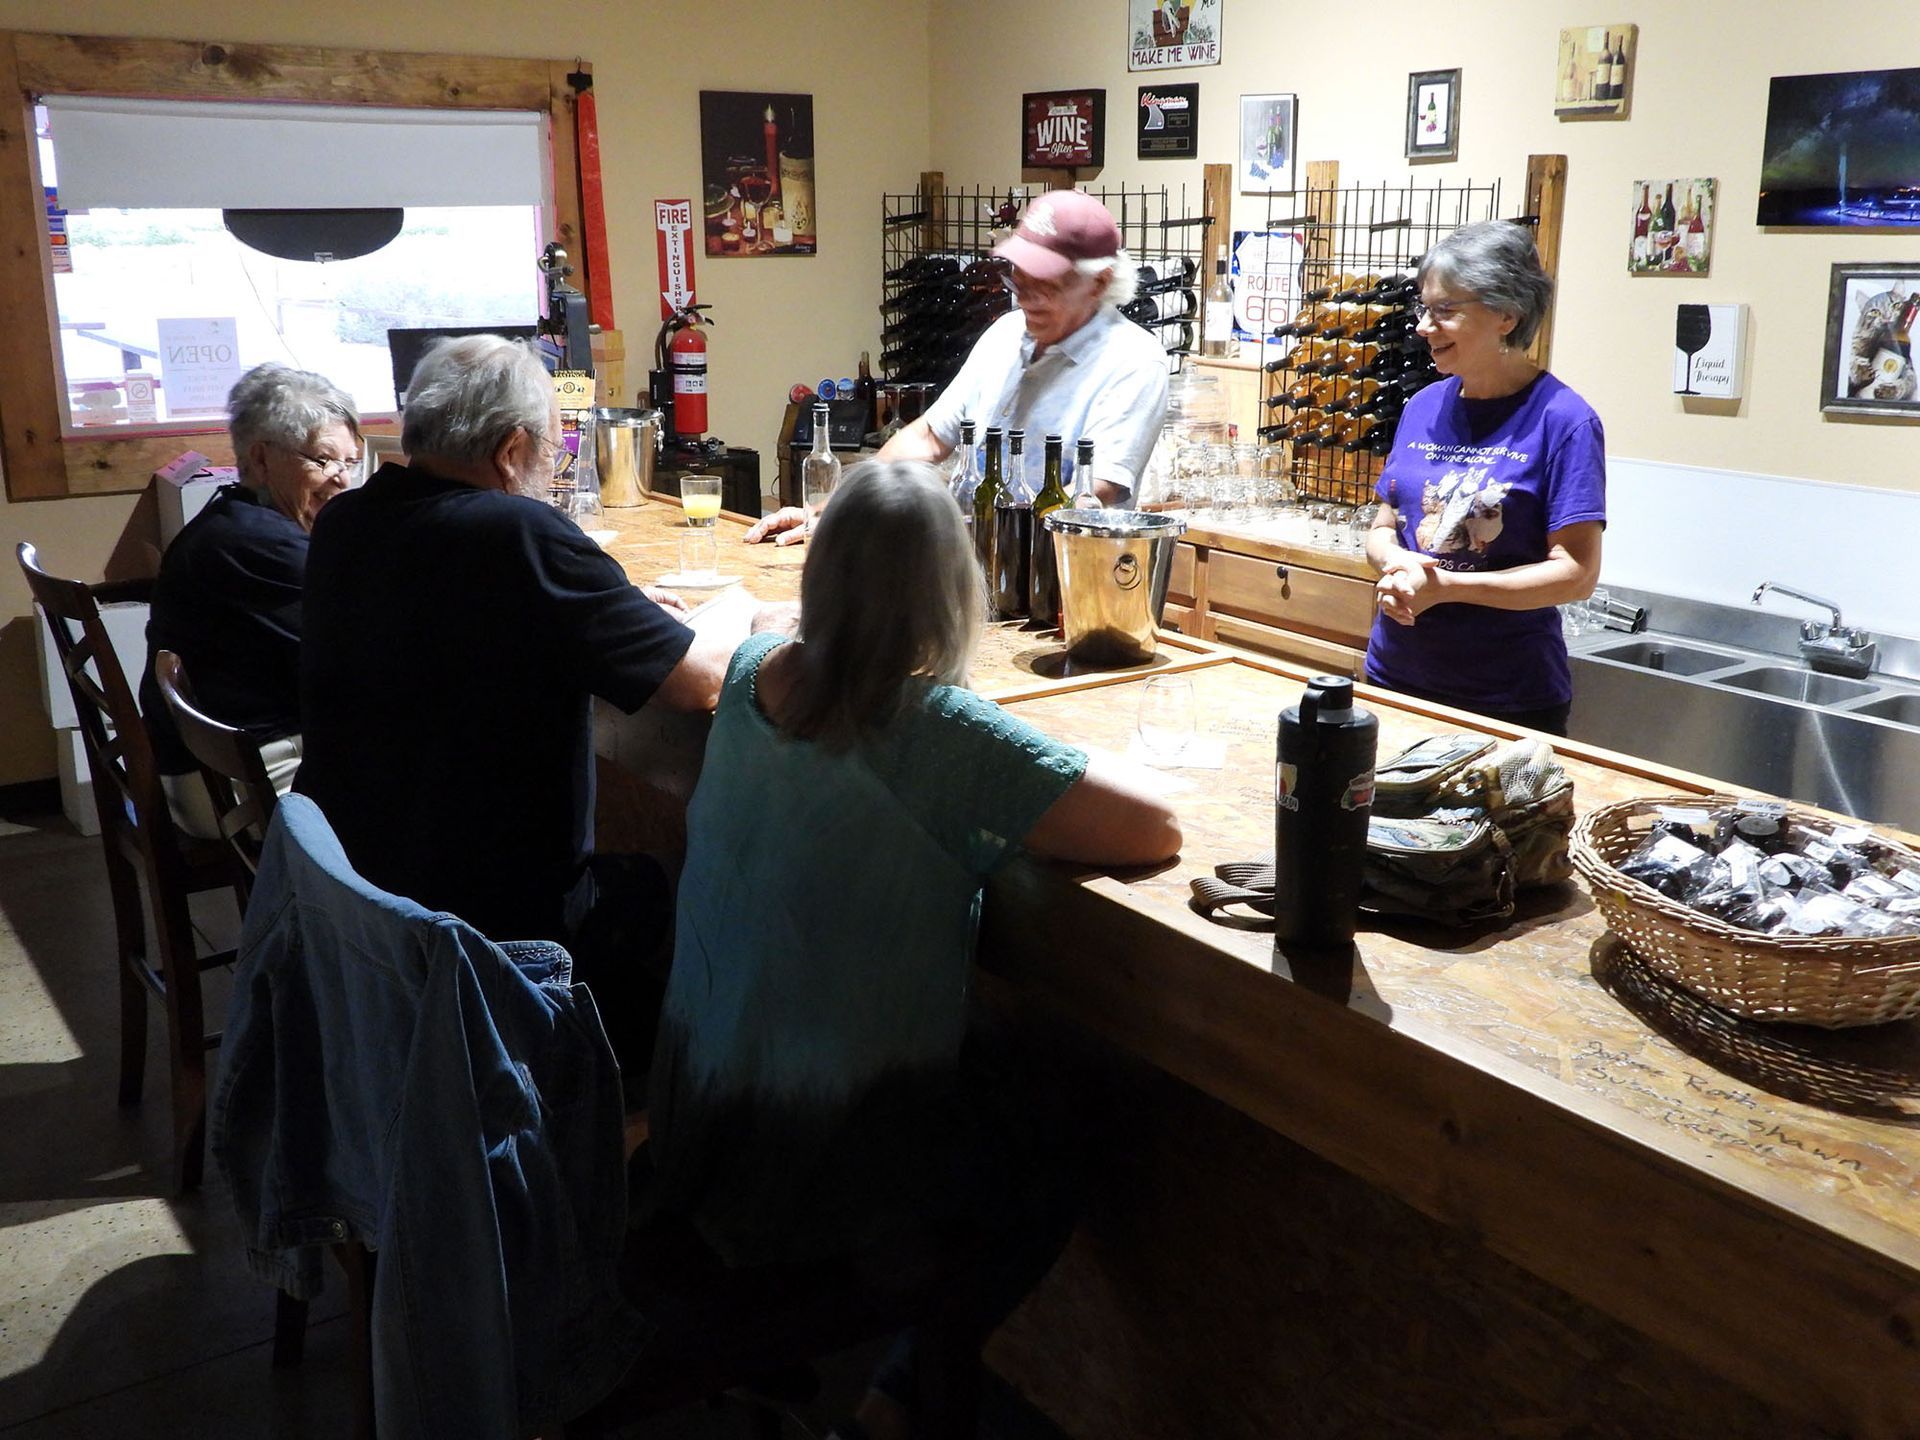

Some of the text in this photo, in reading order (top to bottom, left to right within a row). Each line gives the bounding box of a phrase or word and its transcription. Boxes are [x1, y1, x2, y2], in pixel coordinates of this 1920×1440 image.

[1132, 43, 1217, 66] MAKE ME WINE
[1037, 116, 1088, 147] WINE
[1050, 142, 1074, 157] Often
[659, 208, 689, 224] FIRE
[670, 225, 683, 312] EXTINGUISHER
[1247, 275, 1289, 293] ROUTE
[1246, 295, 1288, 324] 66
[1695, 356, 1725, 371] Liquid
[1696, 370, 1730, 384] Therapy
[1407, 441, 1529, 463] A WOMAN CANNOT SURVIVE
[1424, 452, 1440, 460] ON
[1441, 454, 1463, 463] WINE
[1748, 1119, 1861, 1171] Shawn
